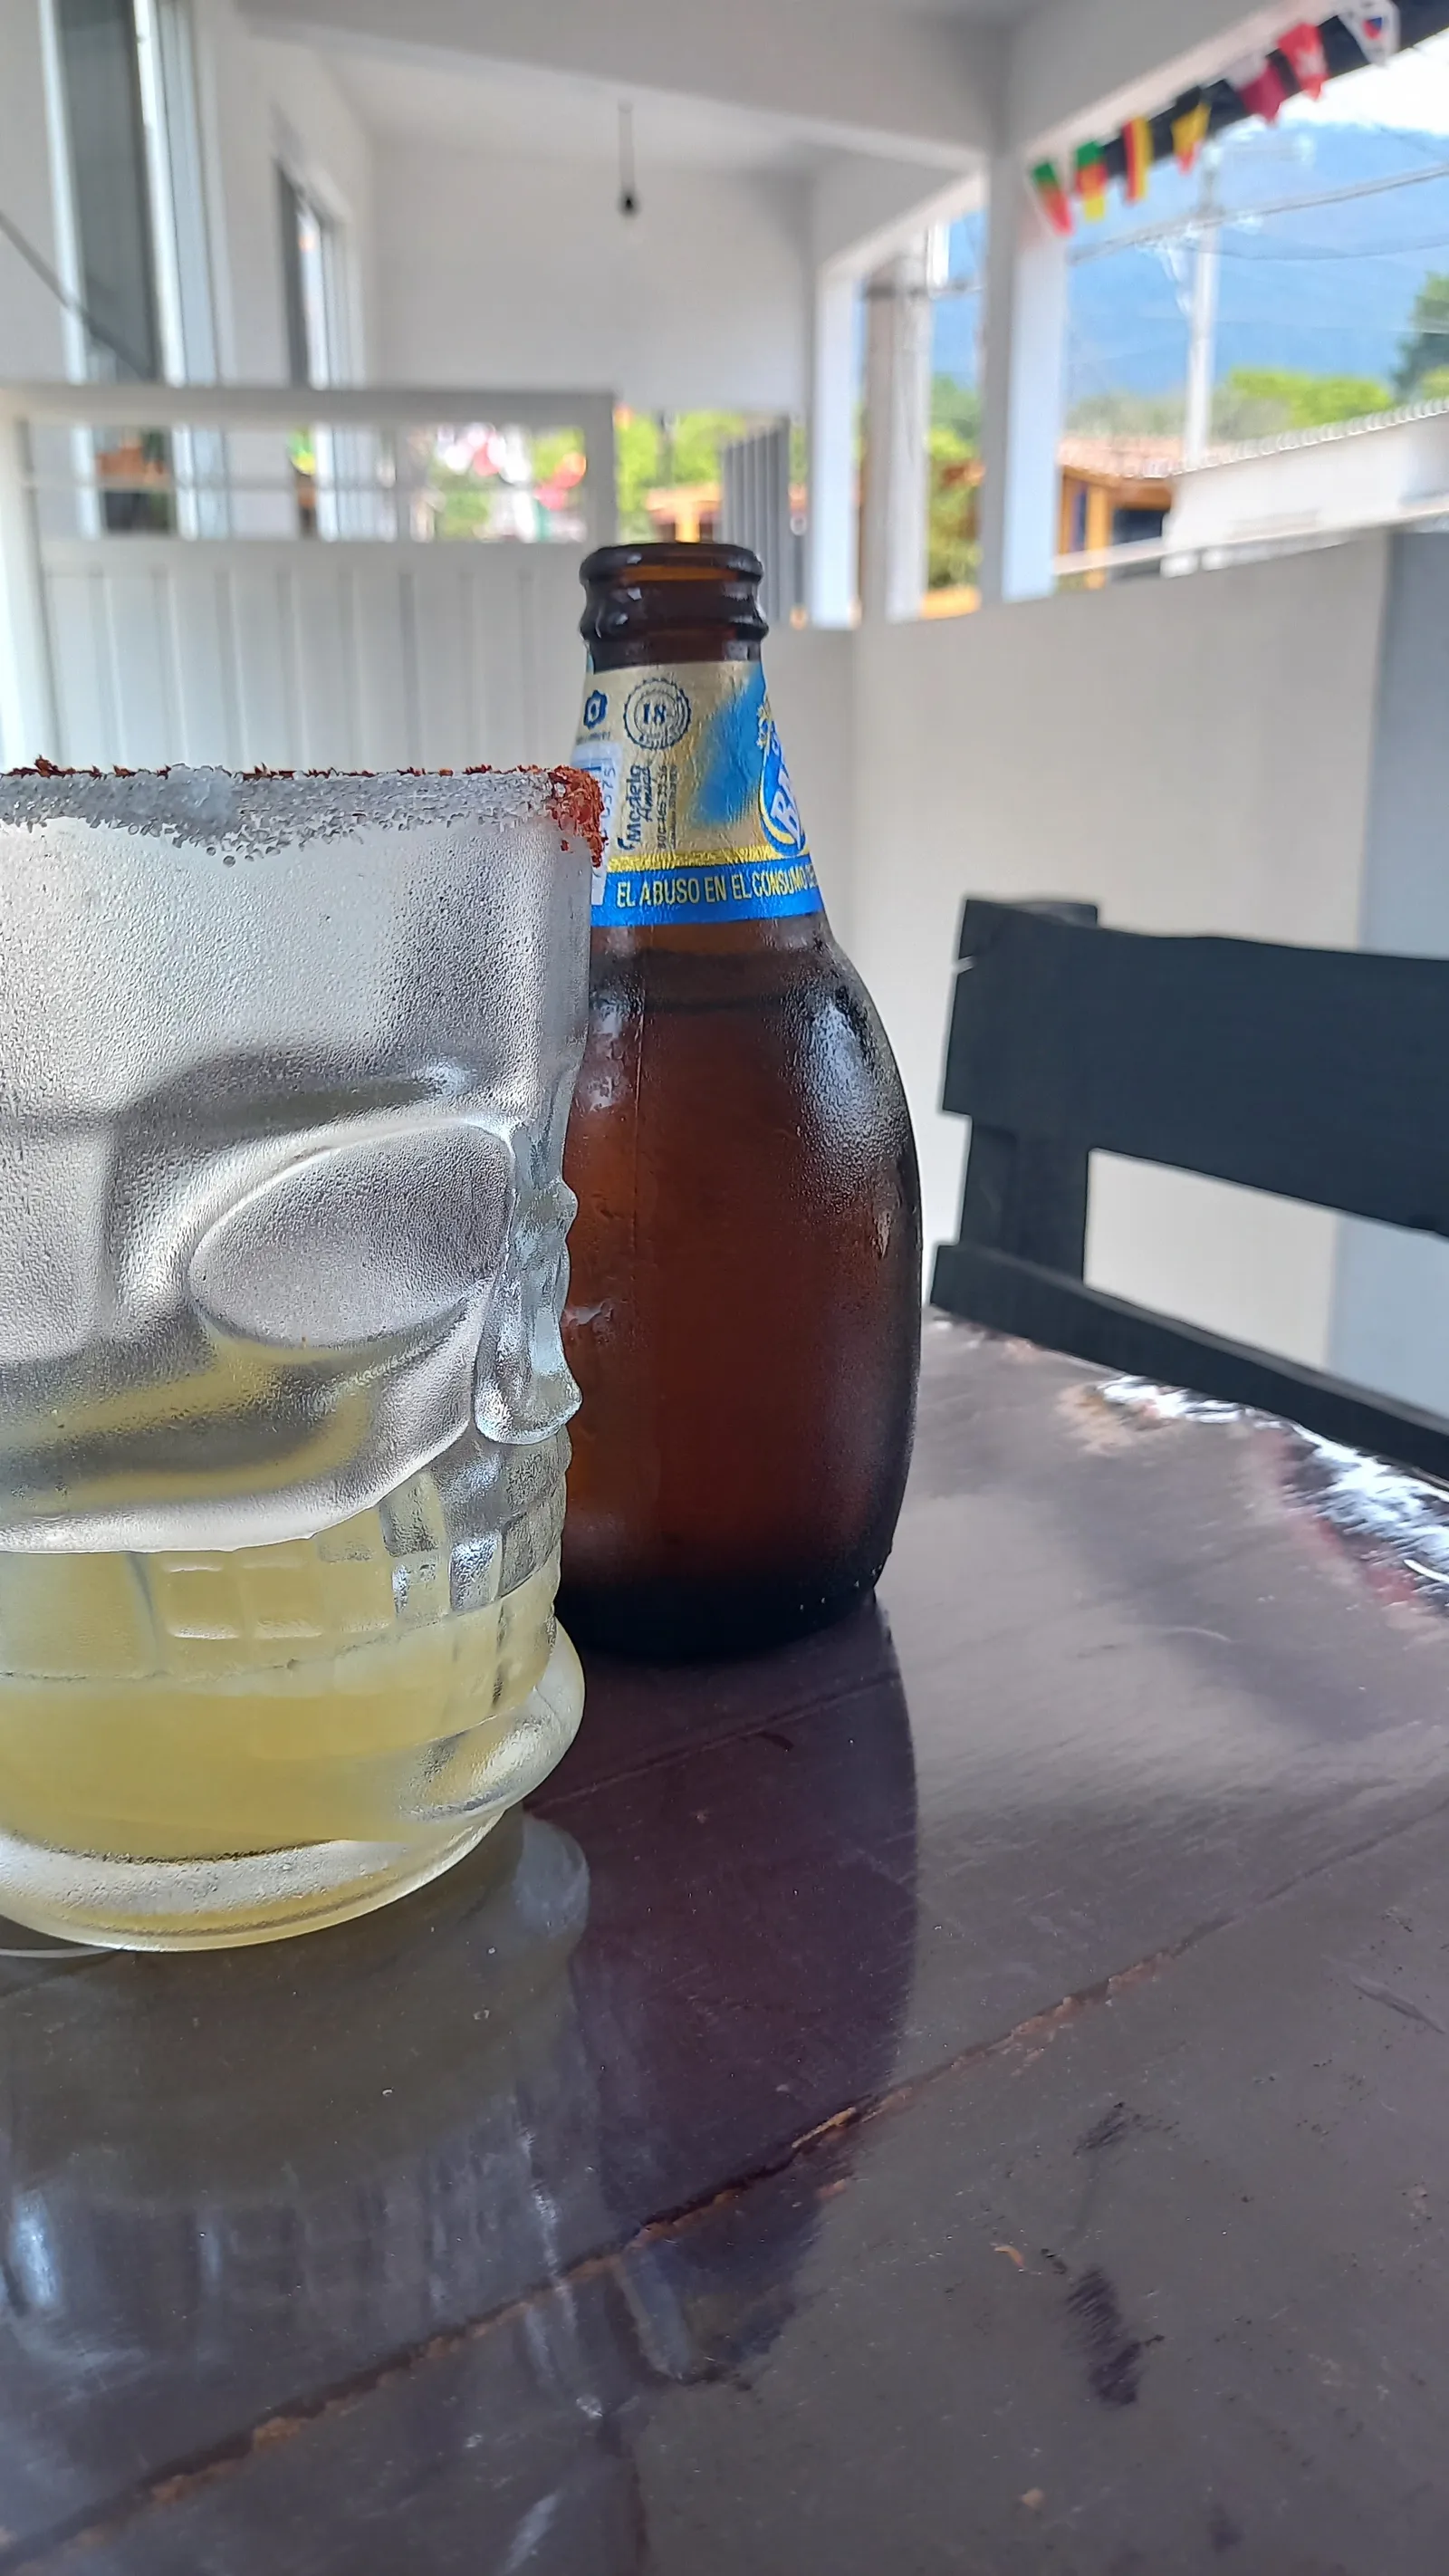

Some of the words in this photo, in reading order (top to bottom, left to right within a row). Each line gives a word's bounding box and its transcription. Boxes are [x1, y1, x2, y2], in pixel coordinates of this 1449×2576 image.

[643, 703, 666, 725] 18
[617, 880, 634, 908] EL
[639, 875, 699, 907] ABUSO
[705, 875, 727, 903] EN
[731, 872, 752, 899] EL
[752, 865, 807, 898] CONSUMO
